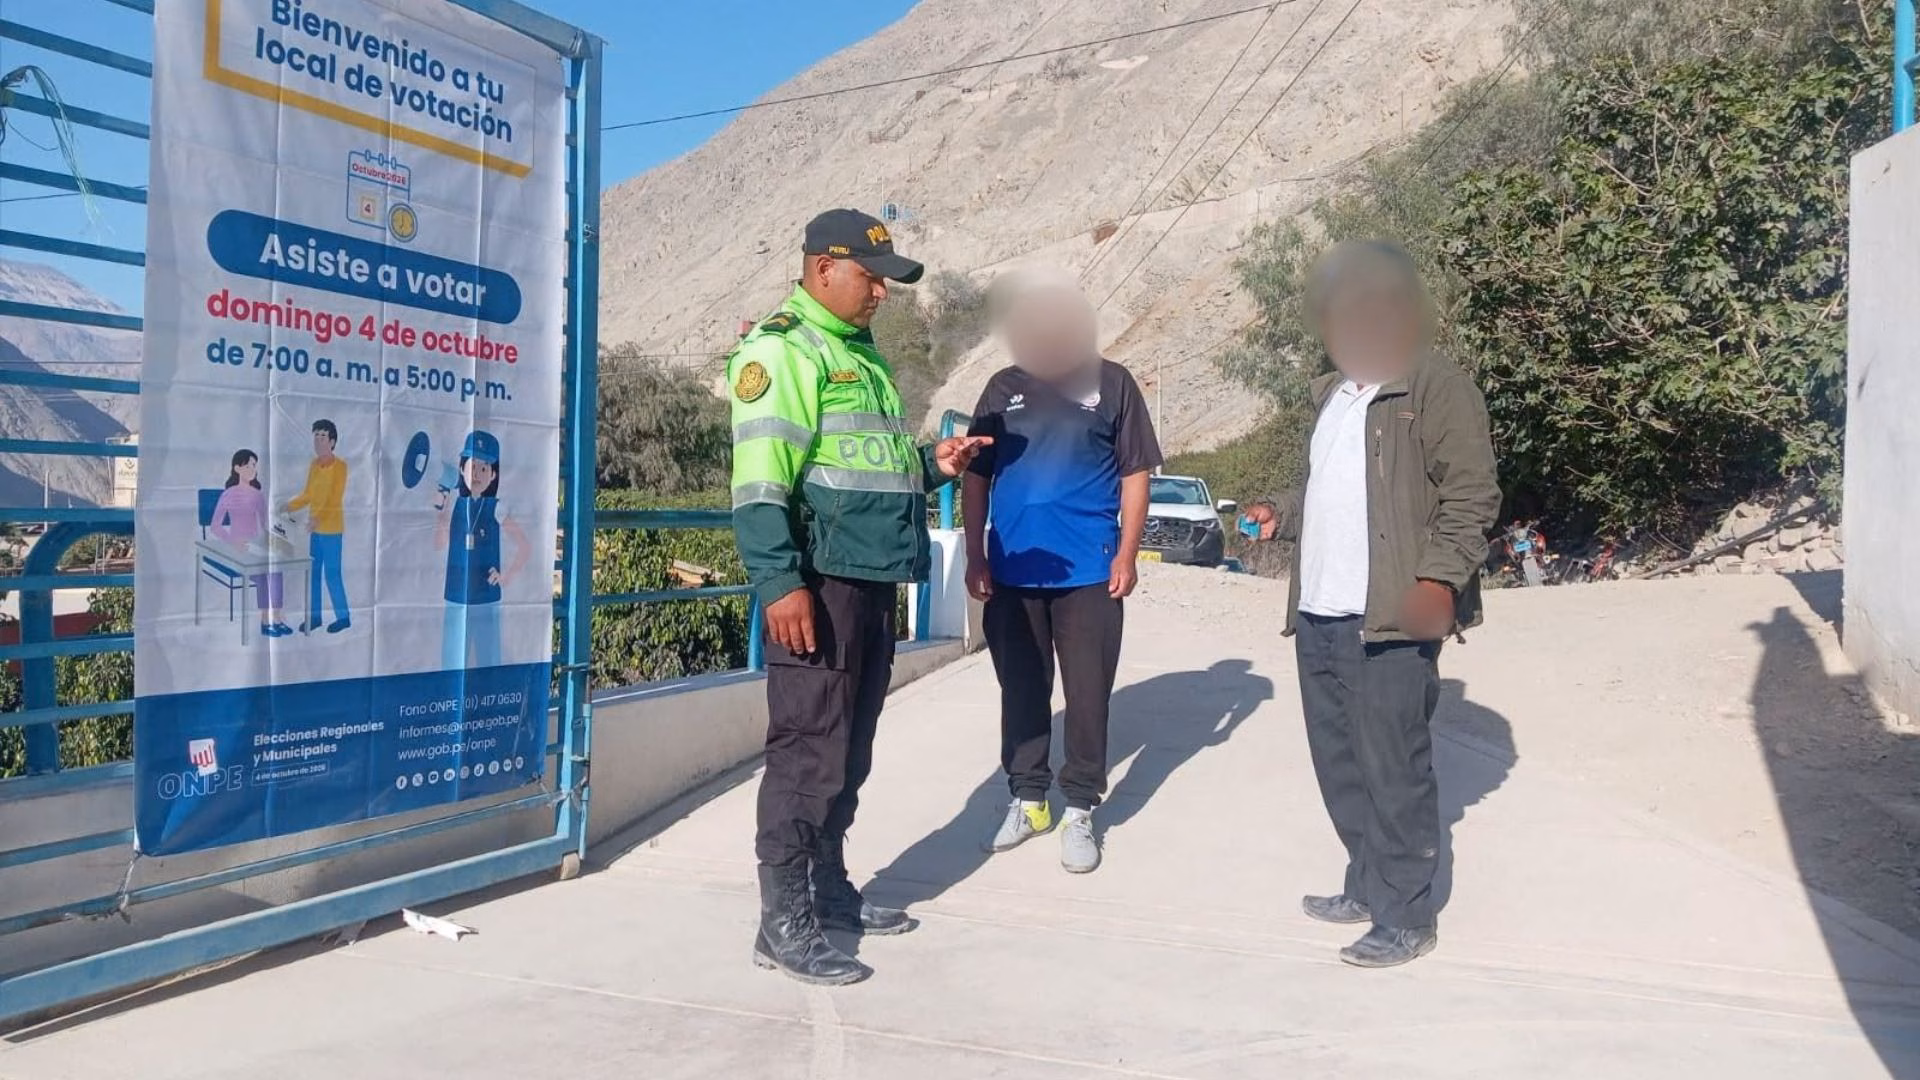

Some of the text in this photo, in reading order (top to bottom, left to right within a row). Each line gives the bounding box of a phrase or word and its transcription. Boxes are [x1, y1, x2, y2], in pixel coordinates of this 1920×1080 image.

[271, 0, 505, 104] Bienvenido a tu
[255, 27, 513, 143] local de votación
[828, 246, 850, 255] PERU
[259, 232, 487, 307] Asiste a votar
[206, 289, 519, 364] domingo 4 de octubre
[206, 338, 244, 367] de
[251, 343, 309, 374] 7:00
[316, 358, 340, 379] a.
[347, 361, 378, 384] m.
[385, 365, 400, 387] a
[407, 365, 456, 393] 5:00
[400, 705, 427, 717] Fono
[429, 699, 458, 714] ONPE
[481, 695, 495, 706] 417
[498, 692, 522, 705] 0630
[253, 720, 385, 746] Elecciones Regionales
[398, 737, 497, 760] www.gob.pe/onpe
[253, 743, 337, 767] y Municipales
[157, 764, 244, 800] ONPE
